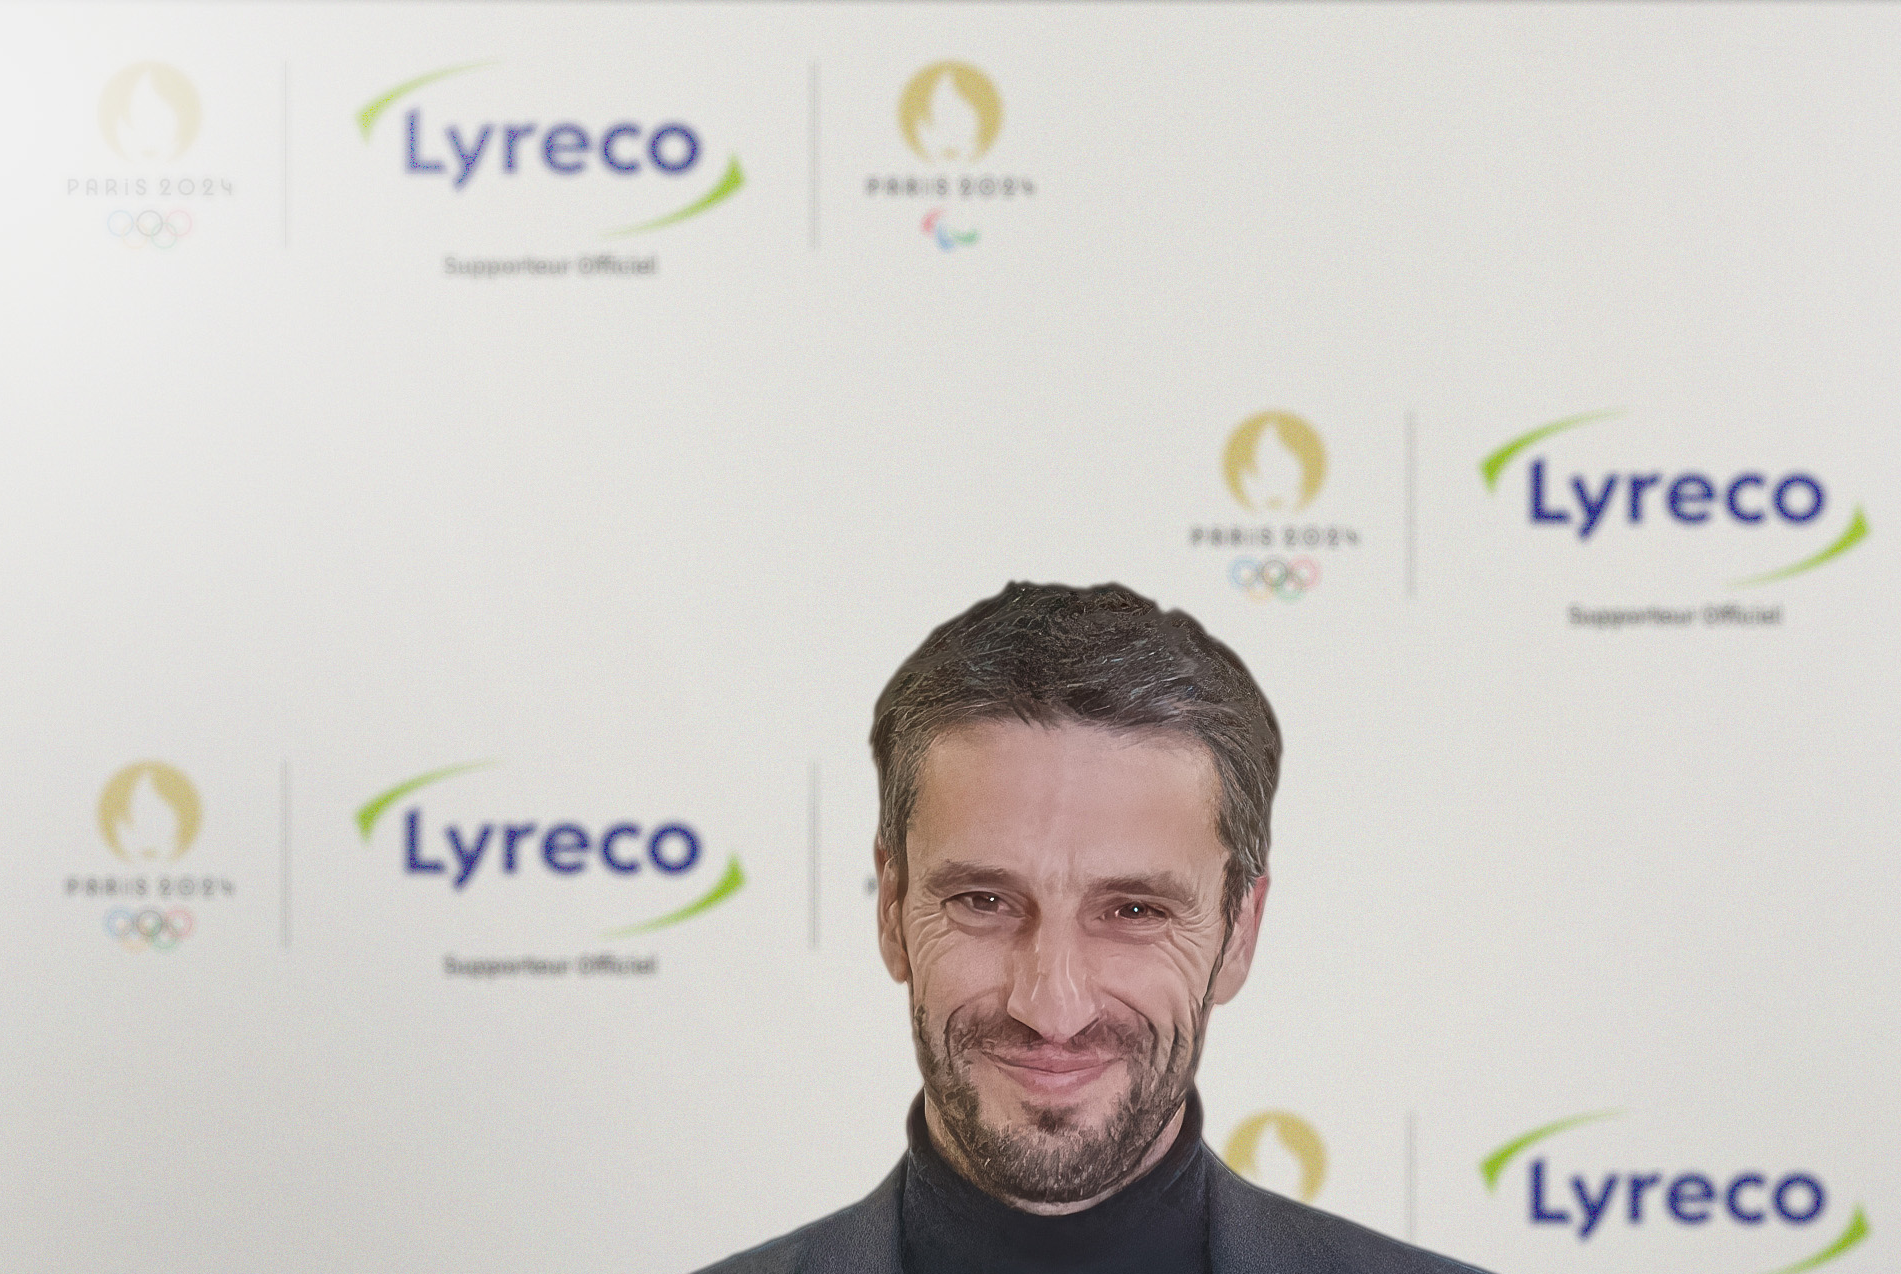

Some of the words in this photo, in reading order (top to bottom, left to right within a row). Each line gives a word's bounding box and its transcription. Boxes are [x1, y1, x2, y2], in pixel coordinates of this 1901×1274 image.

[403, 107, 703, 191] Lyreco
[157, 175, 237, 199] 2024
[958, 175, 1038, 199] 2024
[1528, 457, 1828, 541] Lyreco
[1282, 525, 1362, 549] 2024
[403, 807, 703, 891] Lyreco
[157, 875, 237, 899] 2024
[1528, 1157, 1828, 1241] Lyreco
